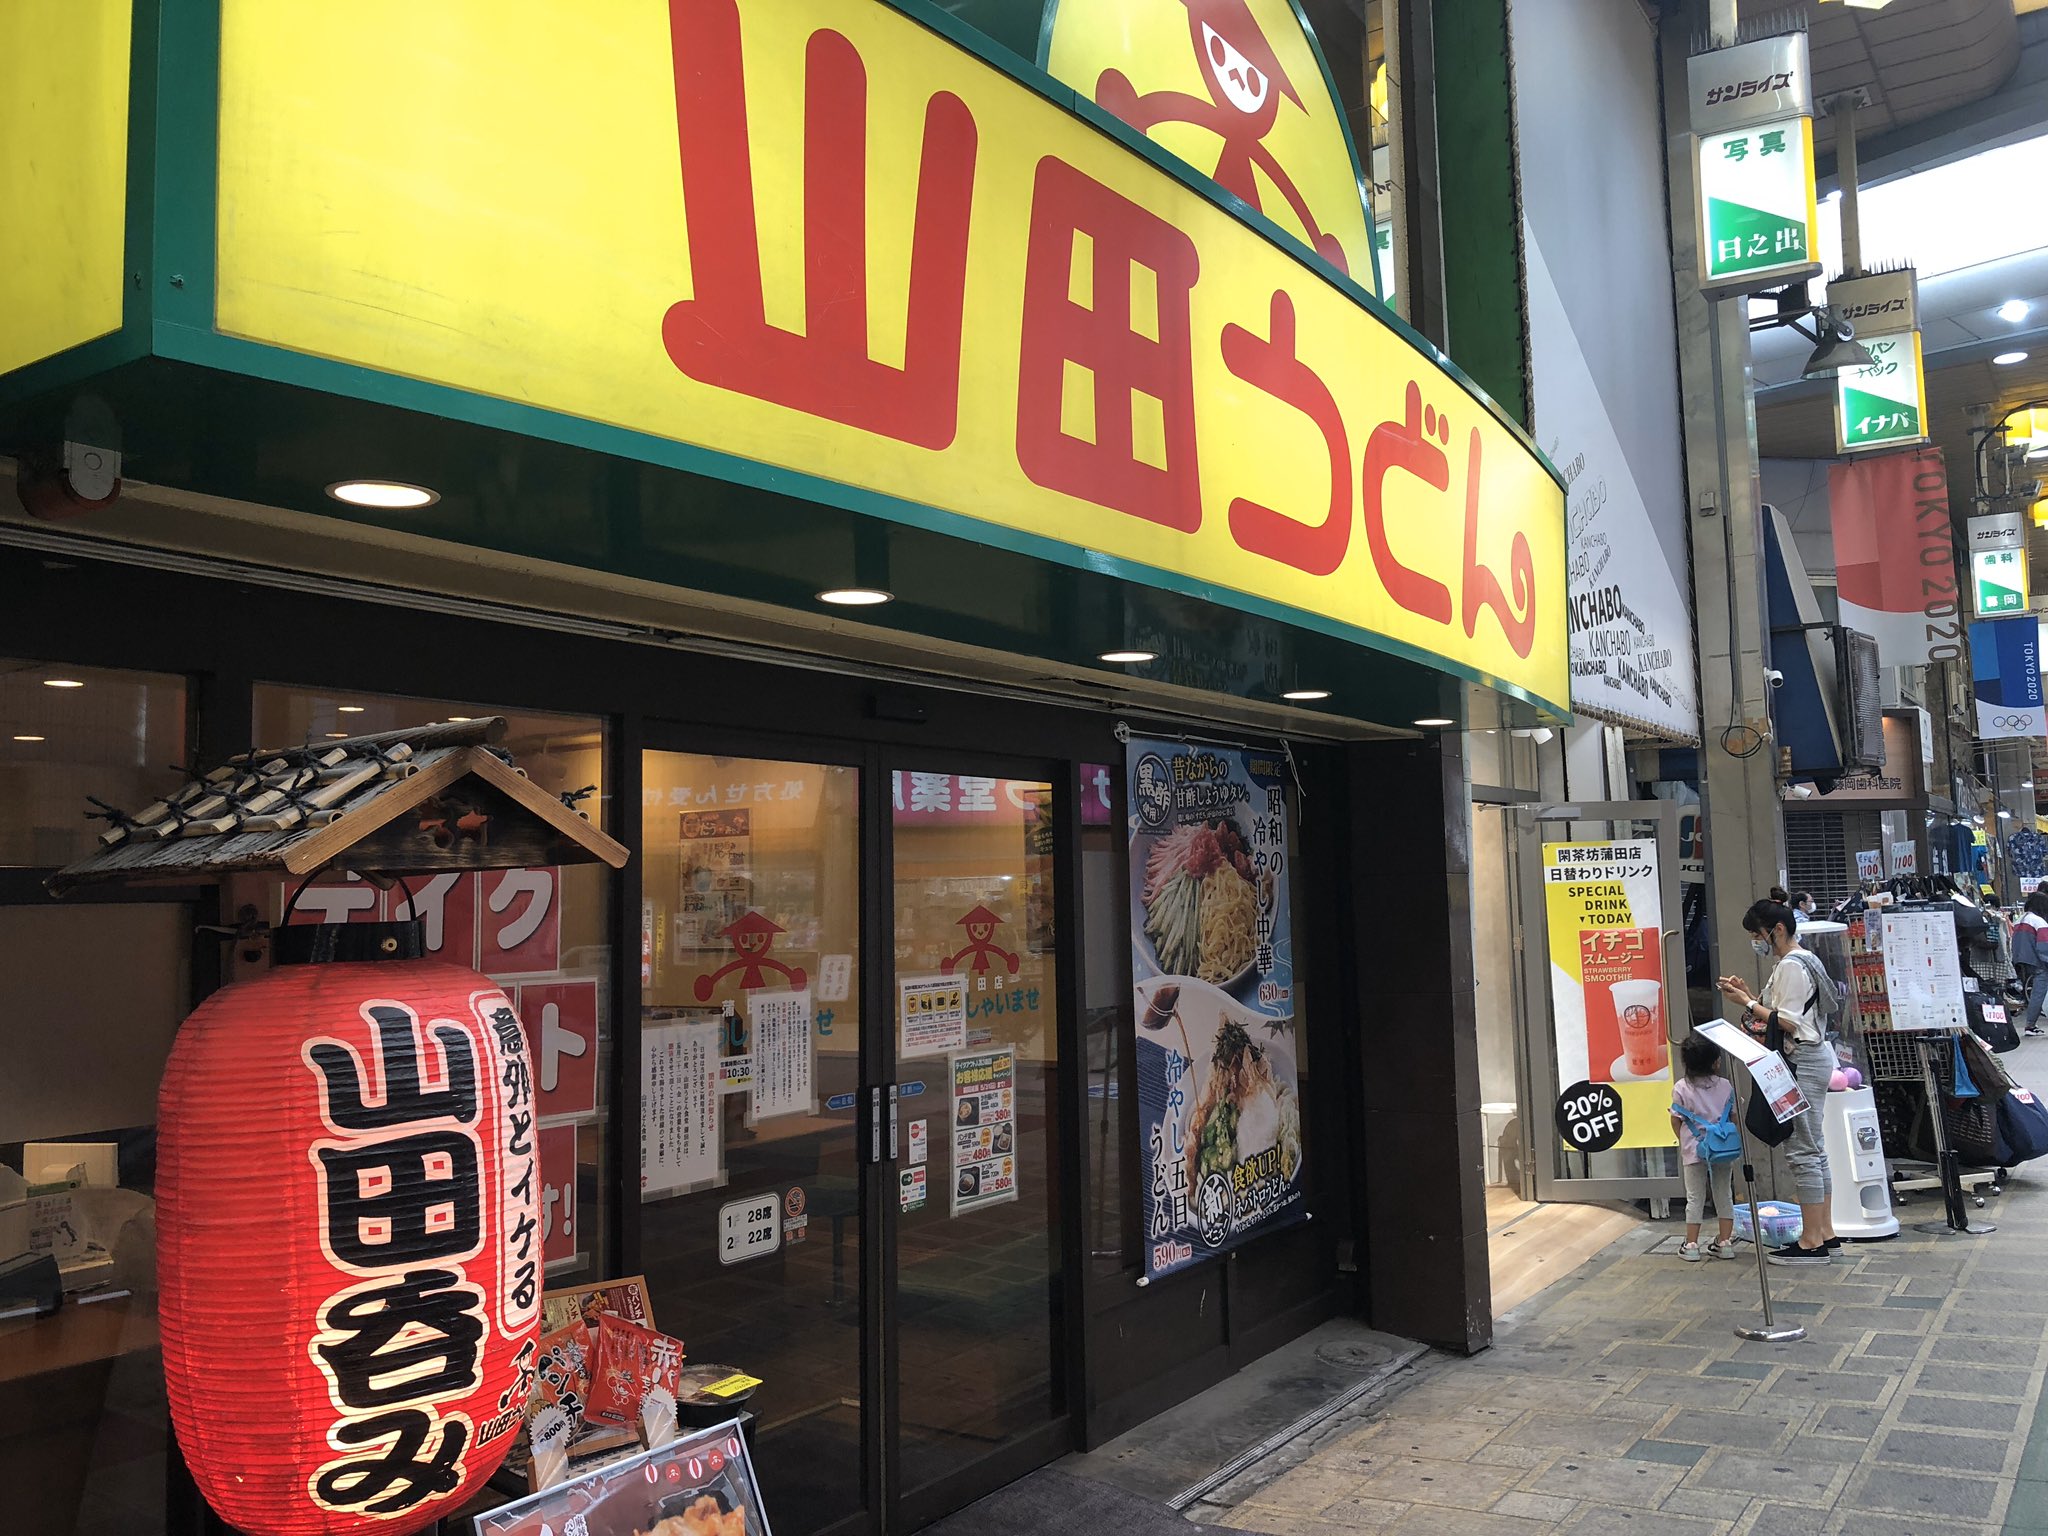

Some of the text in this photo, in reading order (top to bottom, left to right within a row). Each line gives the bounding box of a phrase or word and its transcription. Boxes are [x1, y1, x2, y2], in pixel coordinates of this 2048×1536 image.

[1706, 71, 1794, 105] サンライズ
[1723, 130, 1786, 162] 写真
[1717, 227, 1802, 263] 日之出
[1842, 297, 1908, 320] サンライズ
[660, 0, 1535, 660] 山田うどん
[1855, 411, 1909, 435] イナバ
[1976, 528, 2017, 540] サンライズ
[1911, 447, 1962, 664] TOKYO 2020
[1588, 629, 1631, 658] KANCHABO
[2024, 641, 2038, 701] TOKYO 2020
[1172, 756, 1228, 782] 昔ながらの
[1249, 759, 1282, 777] 期間限定
[1266, 787, 1284, 876] 昭和の
[1558, 846, 1642, 863] 閑茶坊蒲田店
[1550, 864, 1654, 882] 日替わりドリンク
[1252, 816, 1274, 976] 冷やし中華
[1568, 885, 1625, 898] SPECIAL
[1585, 899, 1628, 911] DRINK
[1588, 913, 1633, 925] TODAY
[1582, 929, 1645, 952] イチゴ
[1583, 952, 1645, 965] スムージー
[1583, 966, 1632, 974] STRAWBERRY
[1584, 974, 1633, 983] SMOOTHIE
[1562, 1088, 1614, 1122] 20%
[1166, 1050, 1189, 1229] 冷やし五目
[1572, 1110, 1620, 1144] OFF
[1150, 1126, 1169, 1238] うどん
[305, 1003, 484, 1516] 山田呑み
